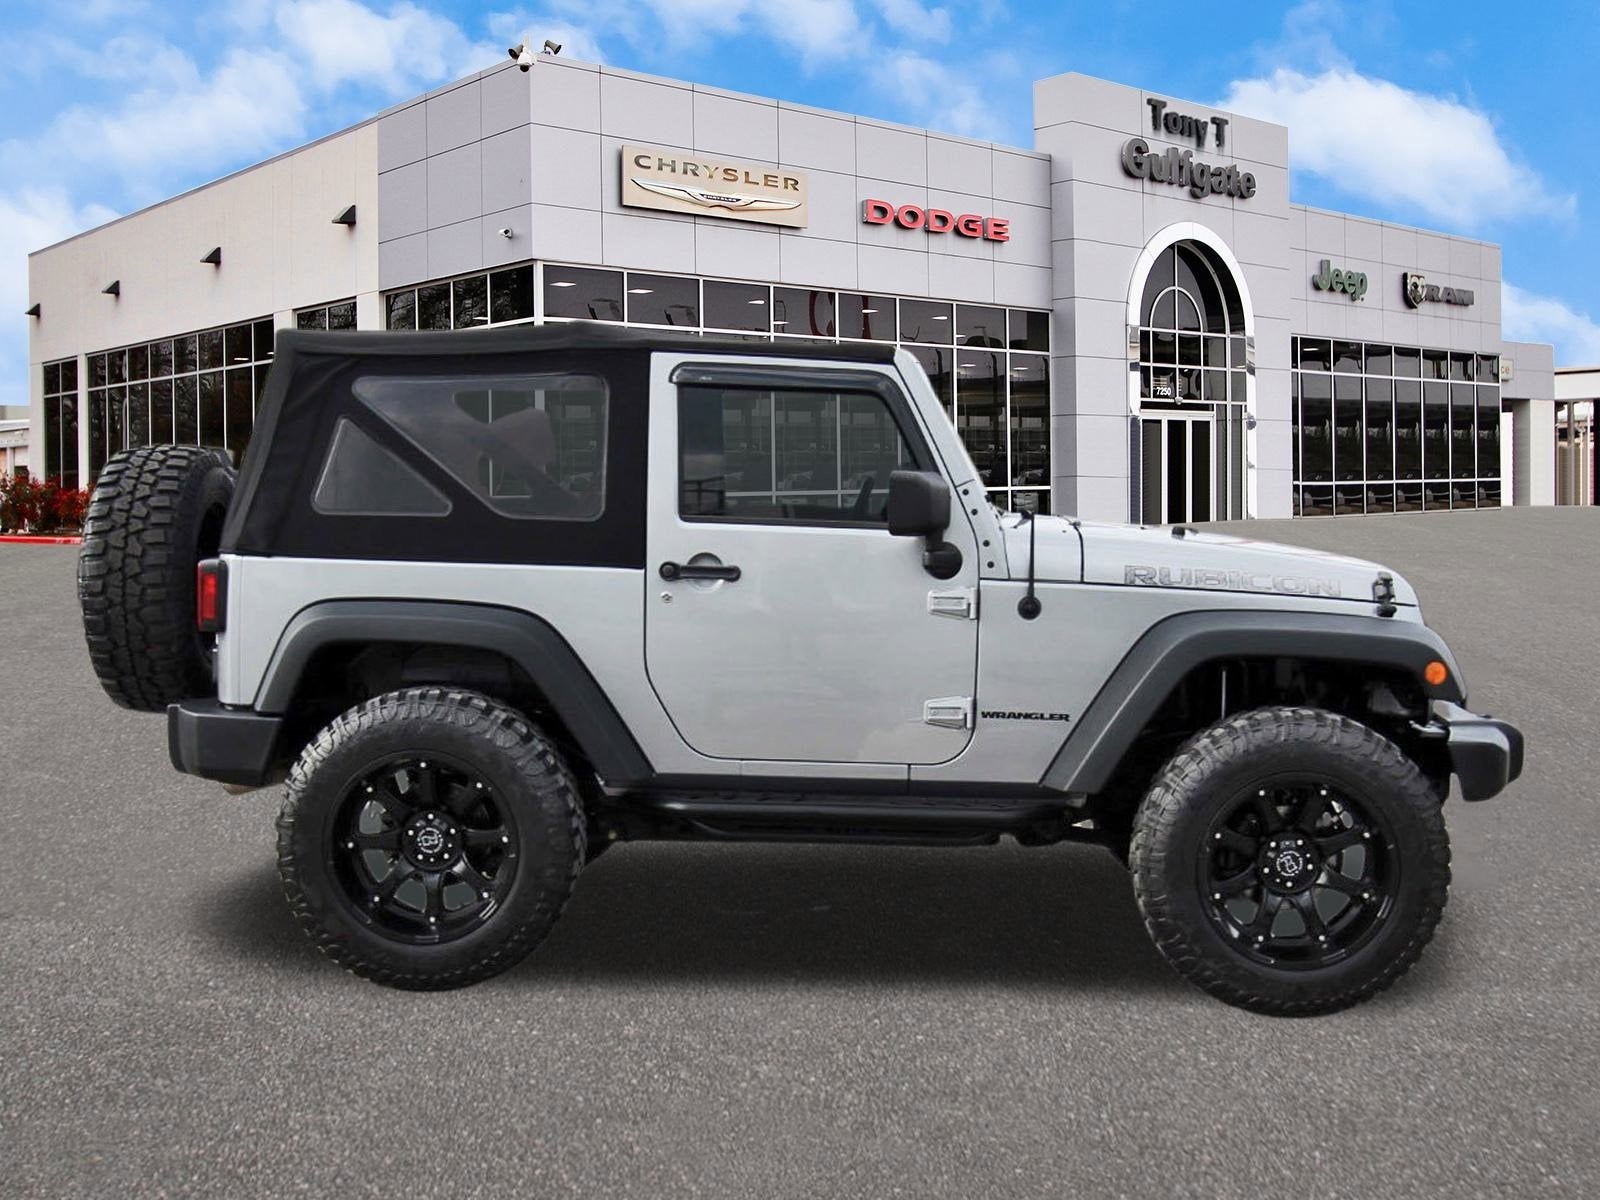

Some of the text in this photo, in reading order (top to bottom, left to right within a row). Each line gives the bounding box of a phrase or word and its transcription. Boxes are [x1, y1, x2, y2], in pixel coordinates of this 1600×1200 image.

[1147, 98, 1229, 147] Tony T
[634, 154, 800, 191] CHRYSLER
[1121, 138, 1256, 198] Gulfgate
[863, 198, 1010, 242] DODGE
[1312, 259, 1368, 302] Jeep
[1425, 284, 1475, 307] RAM
[1124, 565, 1341, 596] RUBICON
[981, 711, 1070, 722] WRANGLER
